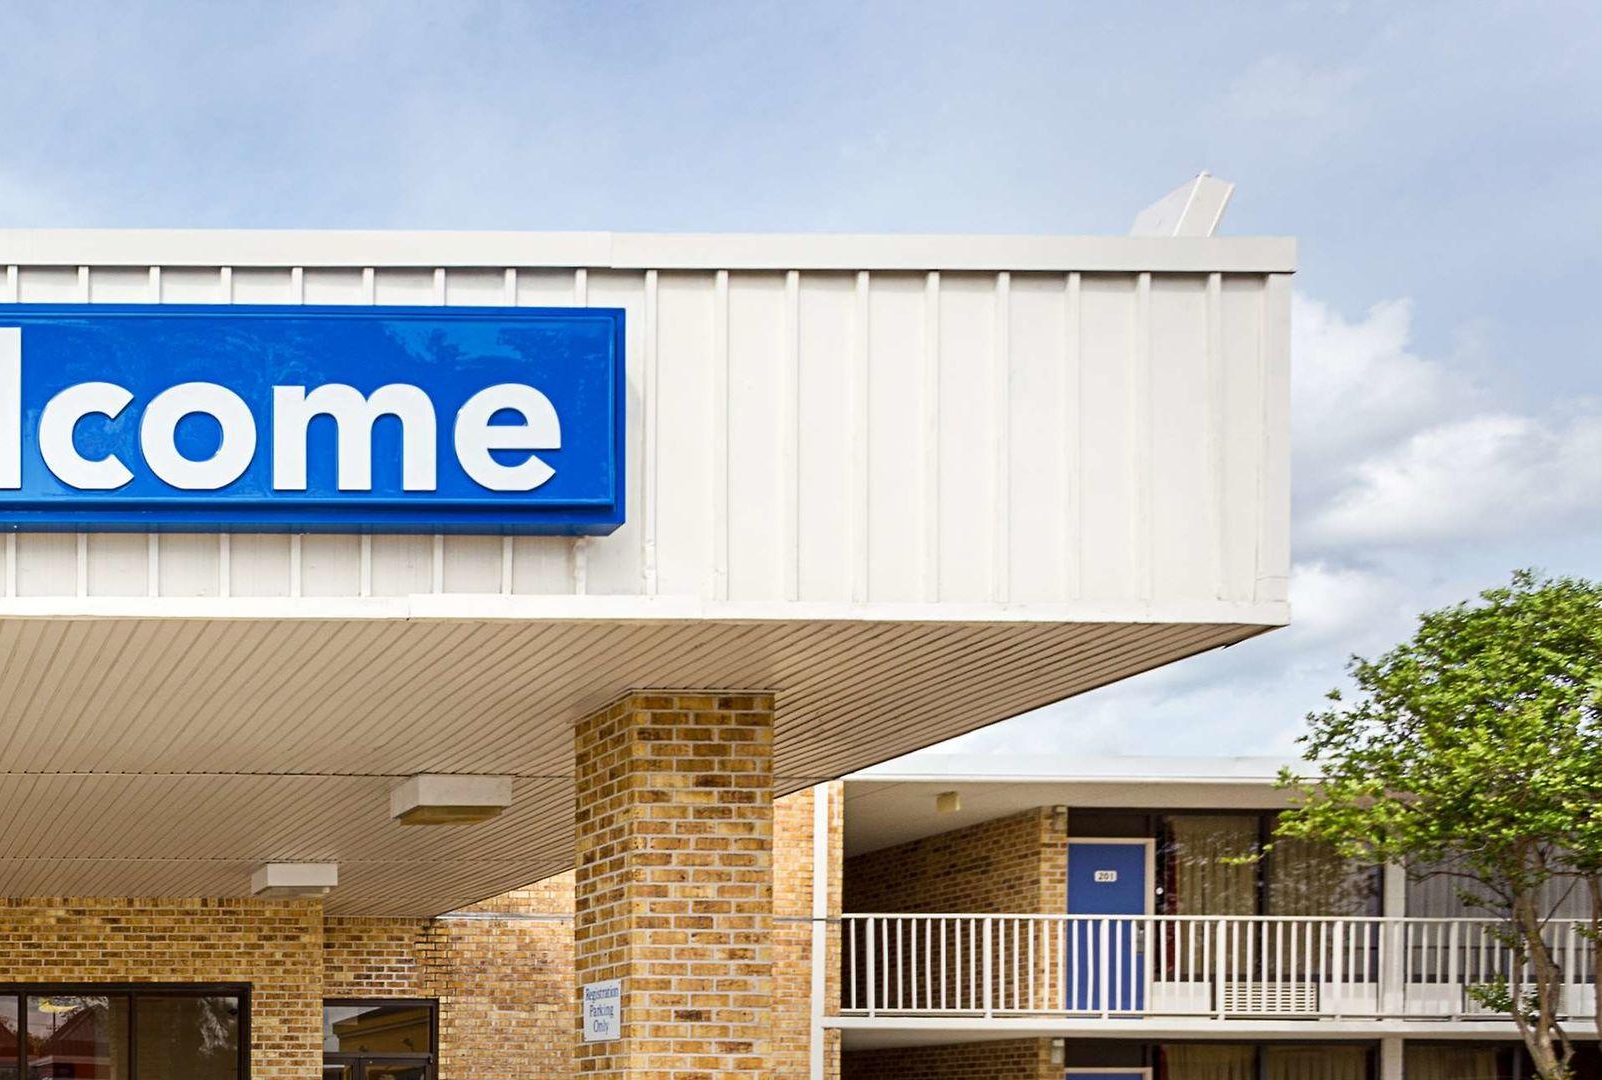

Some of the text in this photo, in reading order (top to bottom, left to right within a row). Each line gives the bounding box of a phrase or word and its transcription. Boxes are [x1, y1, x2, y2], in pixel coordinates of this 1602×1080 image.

[1098, 871, 1114, 880] 201
[585, 986, 619, 1004] Registration
[589, 1004, 614, 1019] Parking
[593, 1019, 609, 1035] Only
